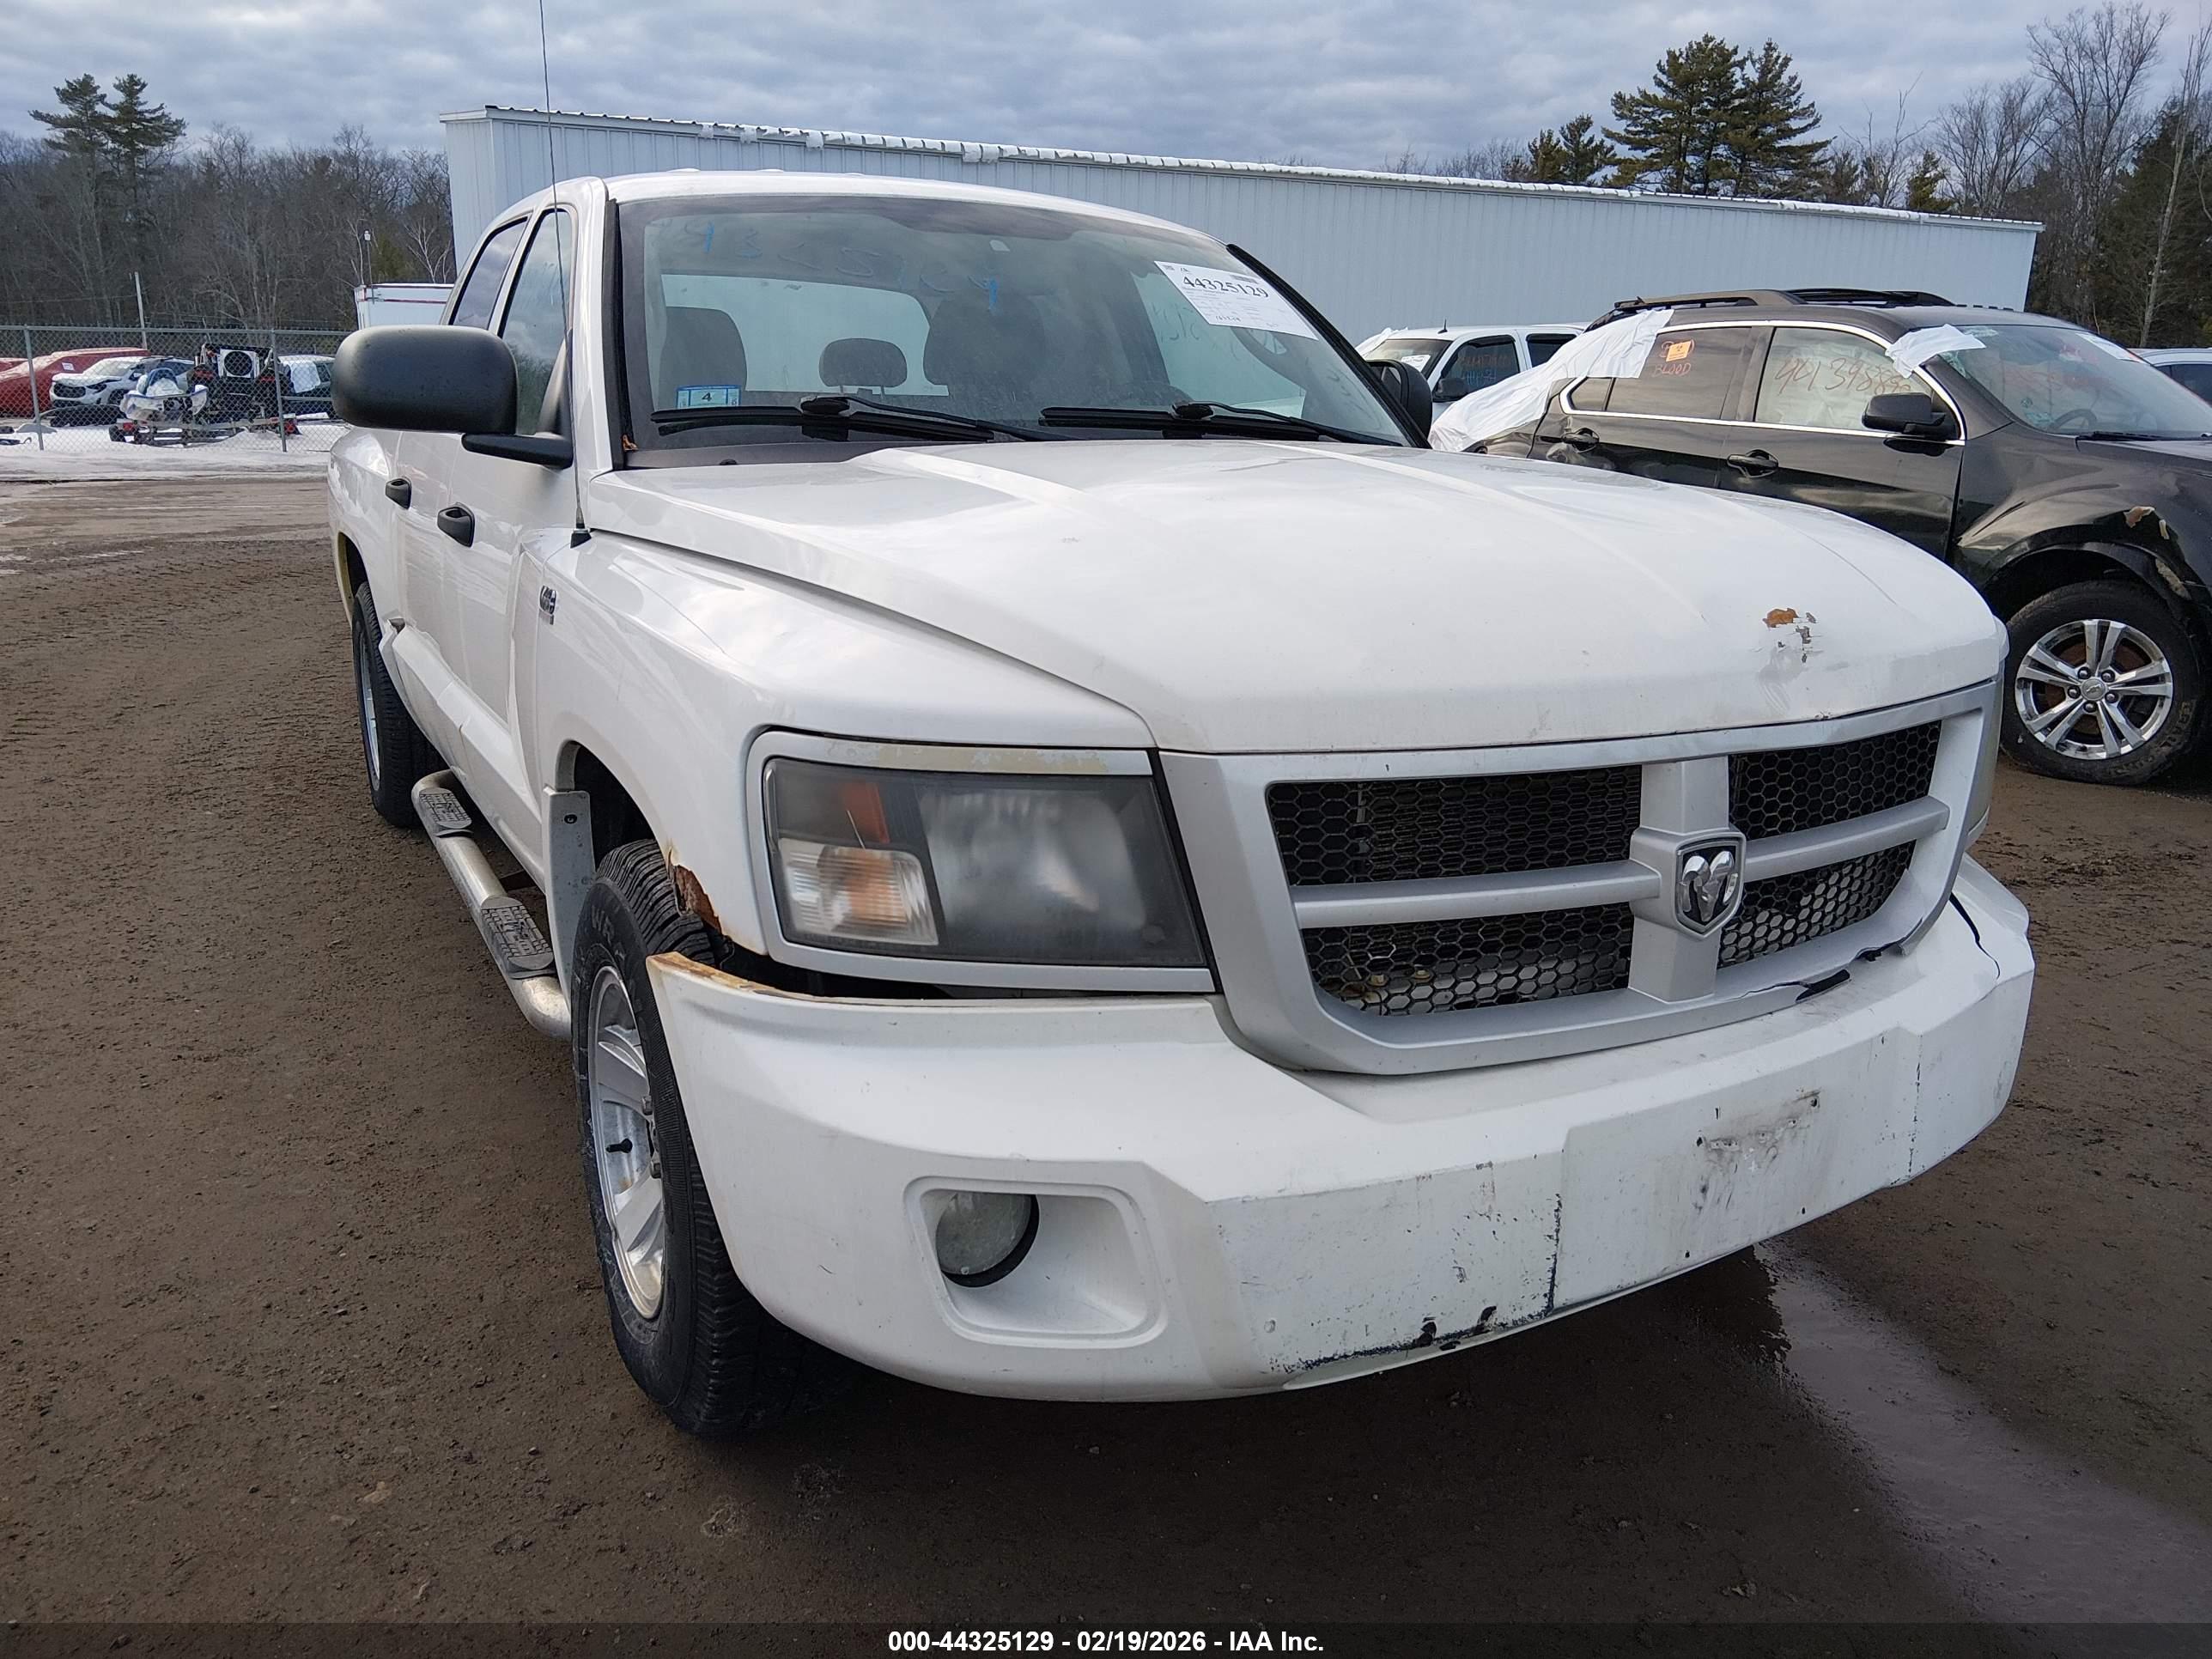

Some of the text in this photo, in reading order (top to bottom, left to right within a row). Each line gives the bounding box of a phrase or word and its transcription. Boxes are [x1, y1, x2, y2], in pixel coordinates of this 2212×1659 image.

[1182, 276, 1269, 298] 44325129
[1652, 362, 1692, 378] BLOOD
[702, 392, 712, 402] 4
